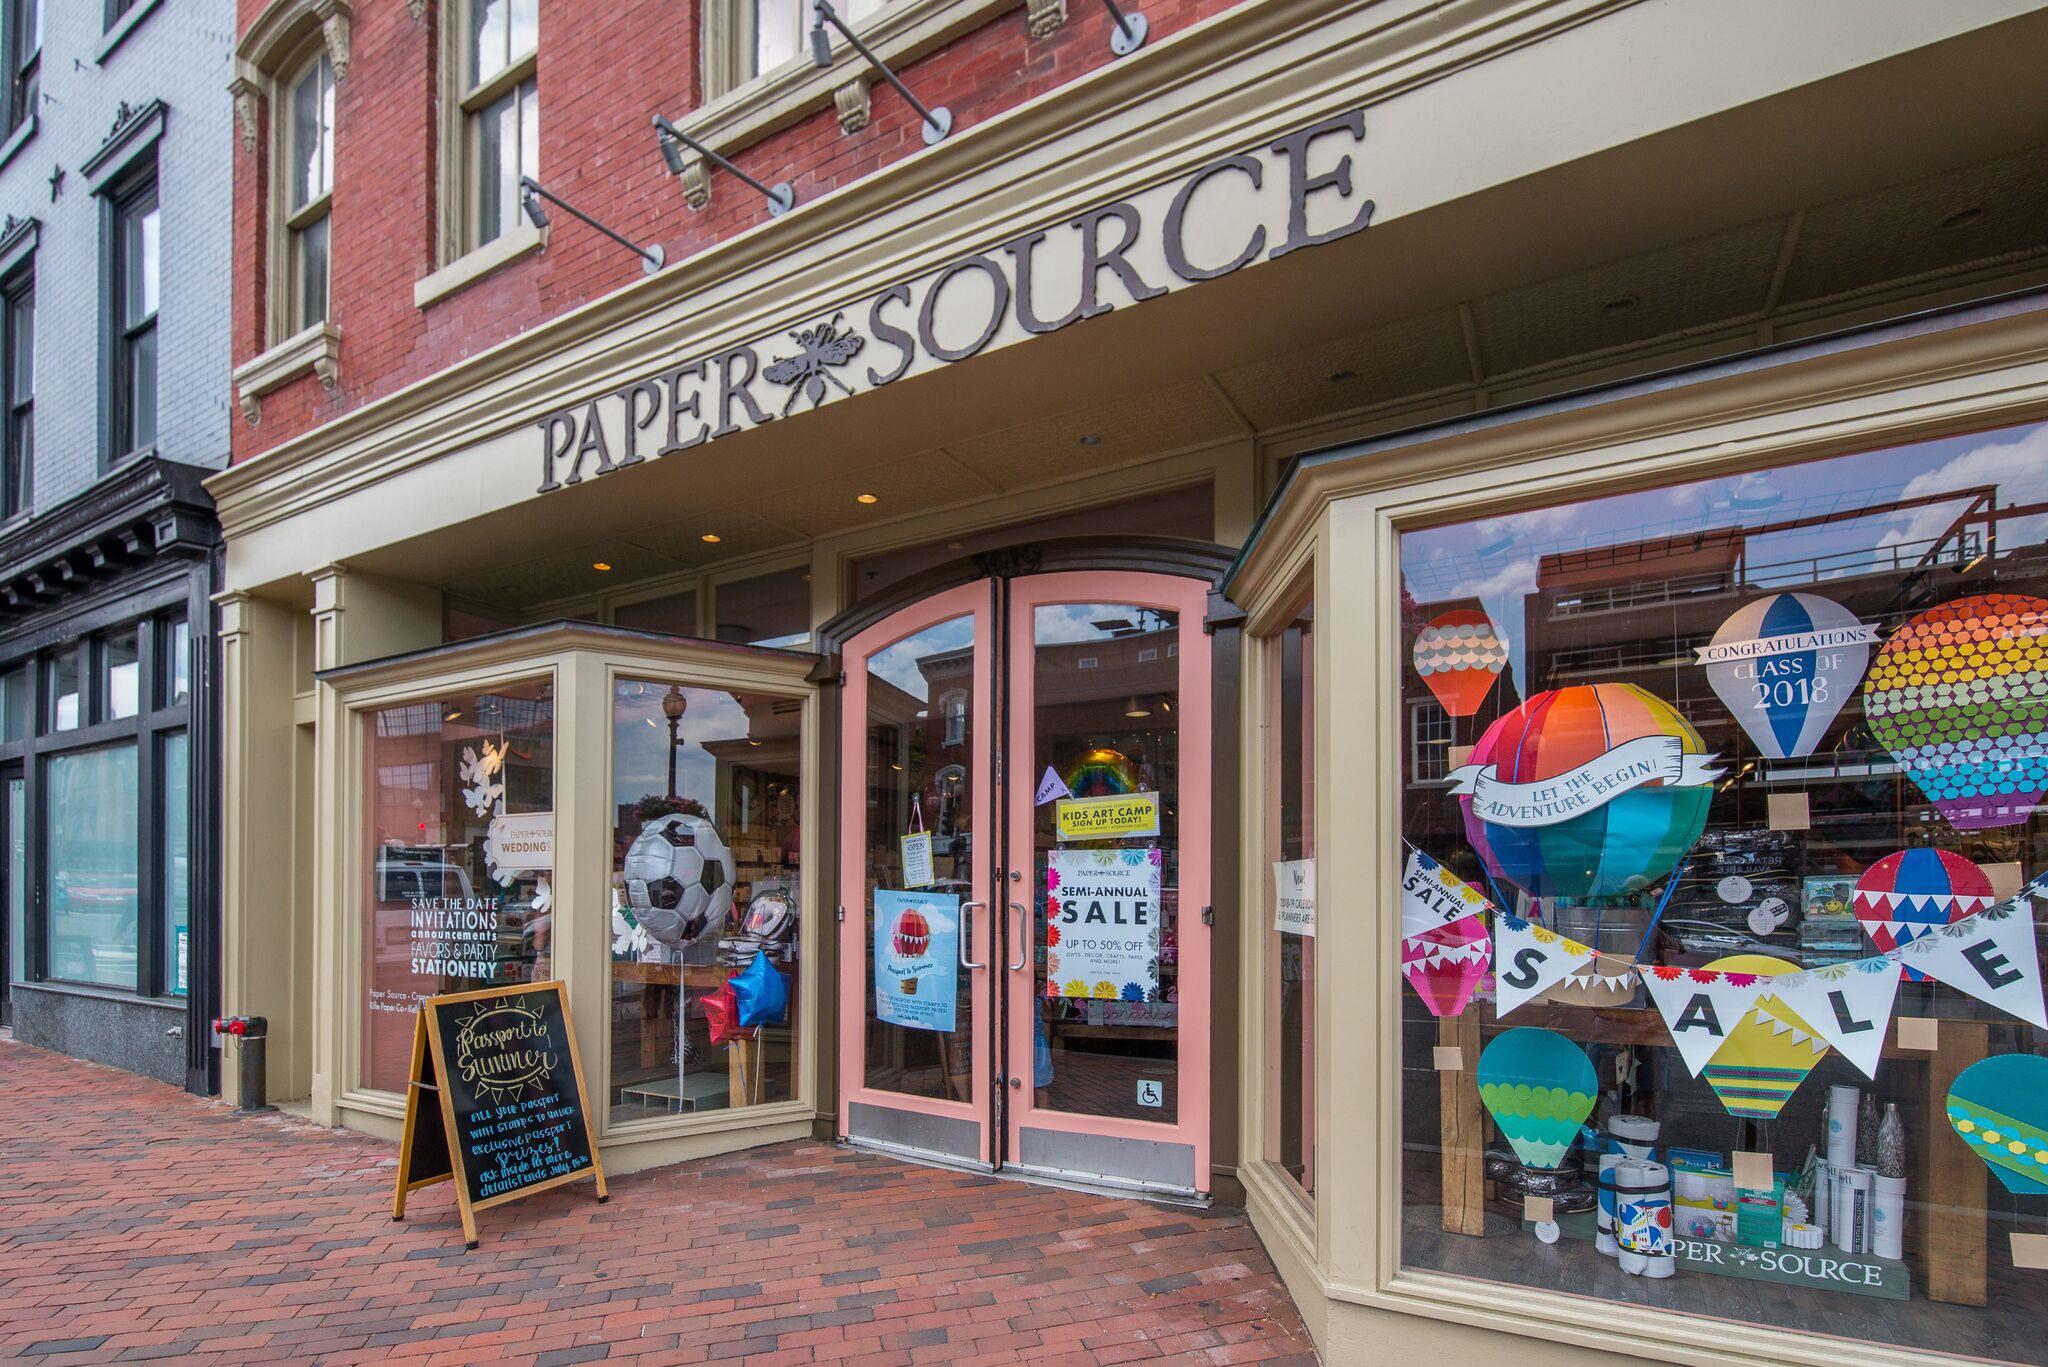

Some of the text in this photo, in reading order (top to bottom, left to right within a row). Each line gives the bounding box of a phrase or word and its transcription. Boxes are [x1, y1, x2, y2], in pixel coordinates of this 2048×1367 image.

[537, 109, 1375, 494] PAPER SOURCE
[1707, 629, 1867, 660] CONGRATULATIONS
[1734, 654, 1844, 680] CLASS OF
[1751, 677, 1829, 709] 2018
[1036, 782, 1055, 802] CAMP
[1483, 758, 1658, 819] ADVENTURE BEGIN!
[1532, 769, 1595, 803] LET THE
[1062, 810, 1088, 821] KIDS
[1093, 808, 1114, 818] ART
[1118, 805, 1152, 817] CAMP
[1072, 815, 1142, 827] SIGN UP TODAY!
[501, 841, 552, 853] WEDDINGS
[907, 842, 925, 851] OPEN
[1061, 886, 1148, 897] SEMI-ANNUAL
[1403, 877, 1460, 922] SALE
[1414, 869, 1465, 911] SEMI-ANNUAL
[411, 898, 498, 910] SAVE THE DATE
[1062, 900, 1148, 925] SALE
[411, 910, 498, 930] INVITATIONS
[411, 930, 497, 941] announcements
[1066, 940, 1144, 951] UP TO 50% OFF
[411, 941, 498, 960] FAVORS & PARTY
[411, 958, 498, 978] STATIONERY
[912, 963, 933, 974] Summer
[369, 989, 385, 999] Paper
[387, 989, 407, 1000] Source
[380, 1002, 395, 1013] Paper
[456, 1020, 532, 1057] Passport
[458, 1048, 558, 1082] Summer
[495, 1136, 560, 1168] prizes!
[480, 1169, 499, 1183] ask
[501, 1162, 530, 1178] inside
[1633, 1236, 1882, 1287] APER SOURCE
